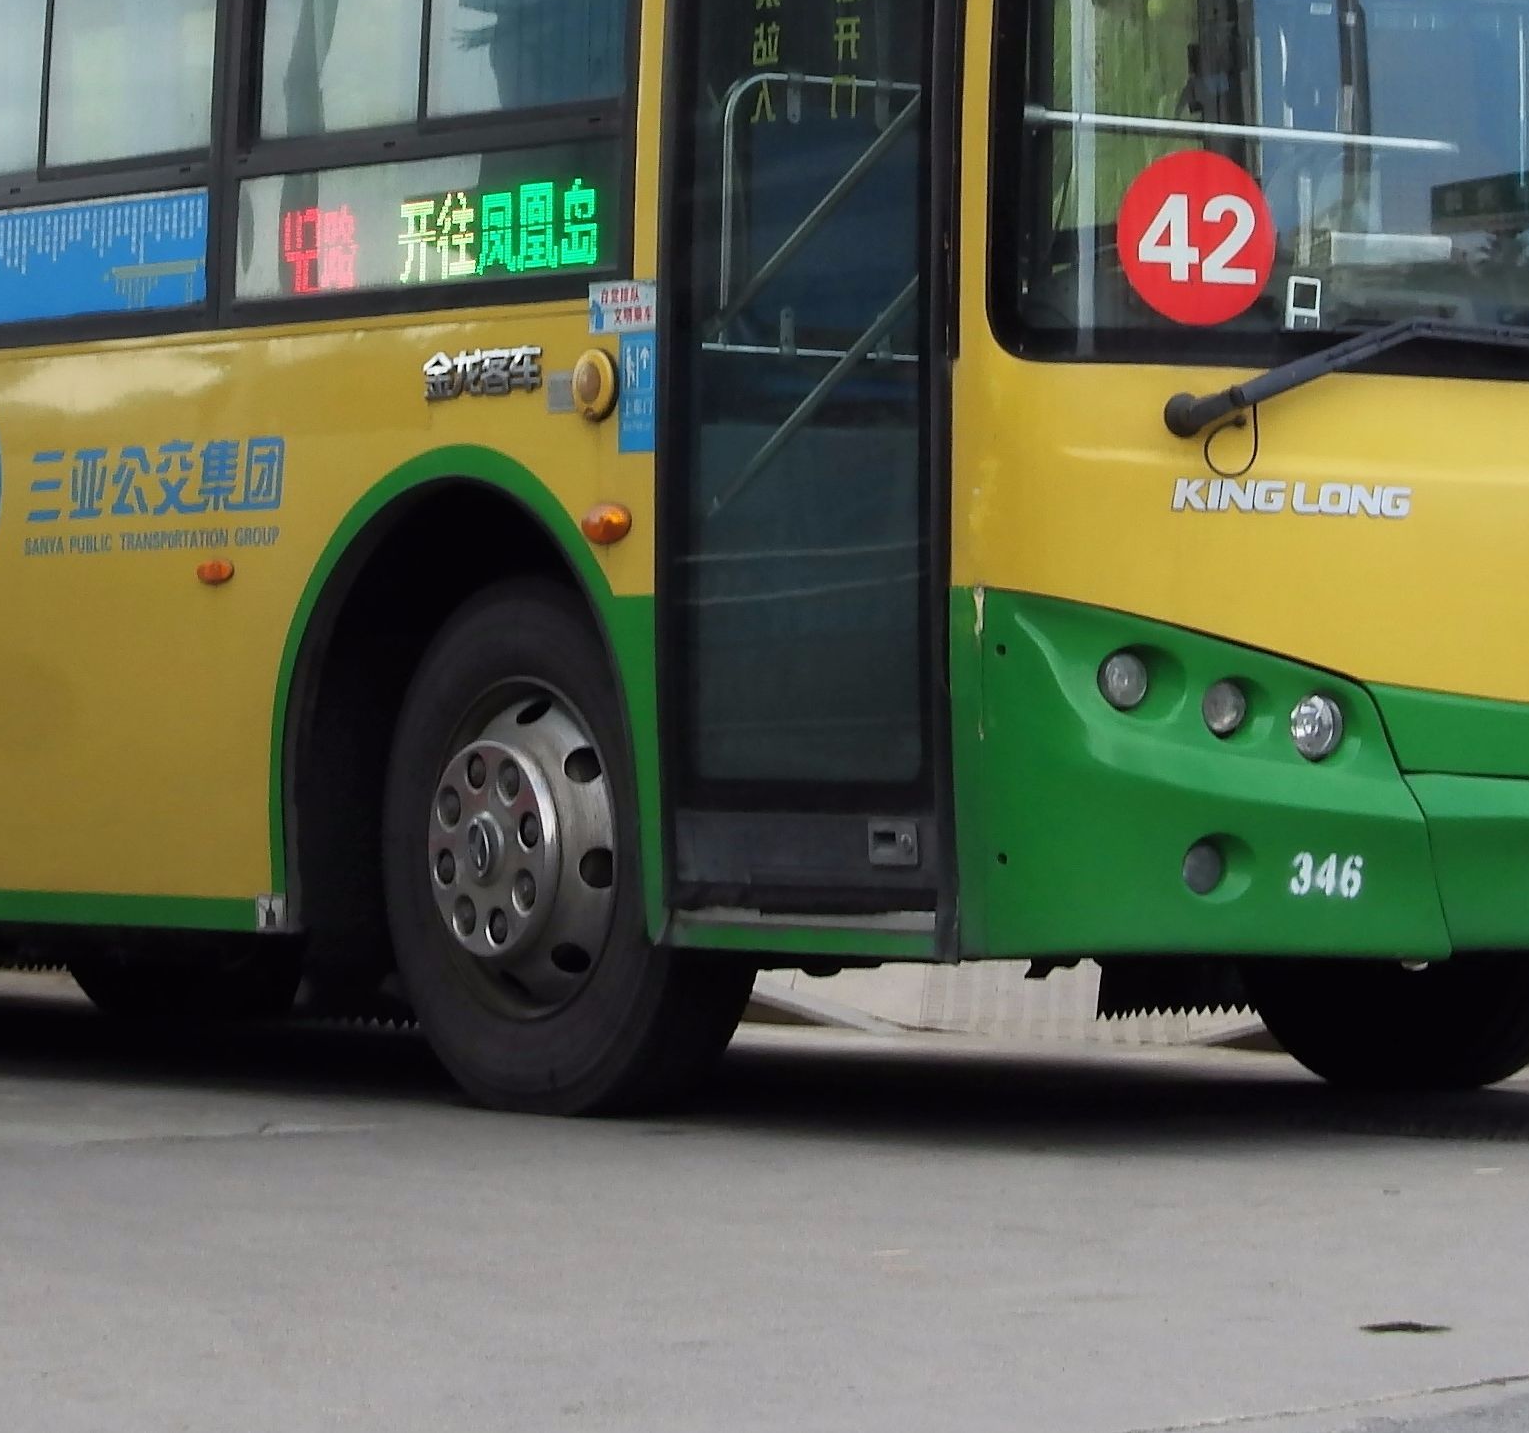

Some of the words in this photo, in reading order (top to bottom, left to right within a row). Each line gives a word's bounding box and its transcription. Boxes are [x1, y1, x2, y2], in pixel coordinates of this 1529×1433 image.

[1138, 193, 1256, 286] 42
[423, 345, 543, 401] 金龙客车
[26, 436, 285, 522] 三亚公交集团
[1172, 478, 1287, 513] KING
[1292, 481, 1412, 519] LONG
[24, 535, 64, 555] SANYA
[69, 533, 112, 553] PUBLIC
[120, 527, 229, 550] TRANSPORTATION
[234, 525, 280, 546] GROUP
[1288, 851, 1365, 900] 346
